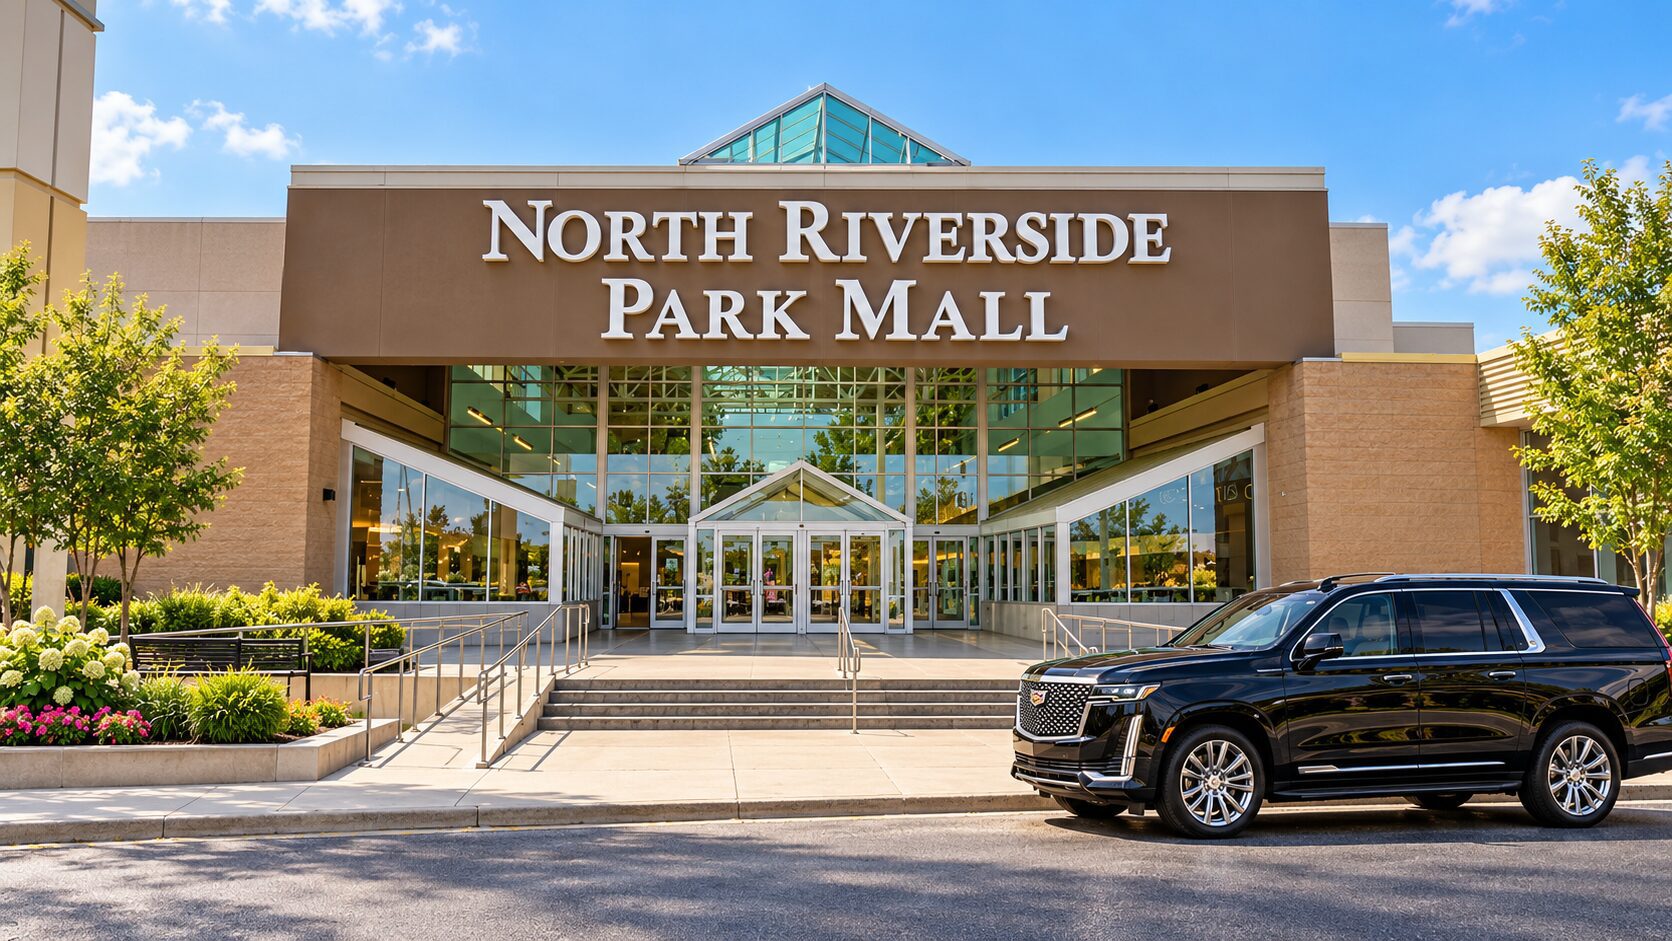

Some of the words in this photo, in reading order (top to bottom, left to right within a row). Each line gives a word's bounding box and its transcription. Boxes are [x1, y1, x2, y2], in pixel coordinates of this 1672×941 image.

[482, 199, 754, 262] NORTH
[778, 200, 1173, 264] RIVERSIDE
[600, 278, 811, 341] PARK
[834, 278, 1070, 342] MALL
